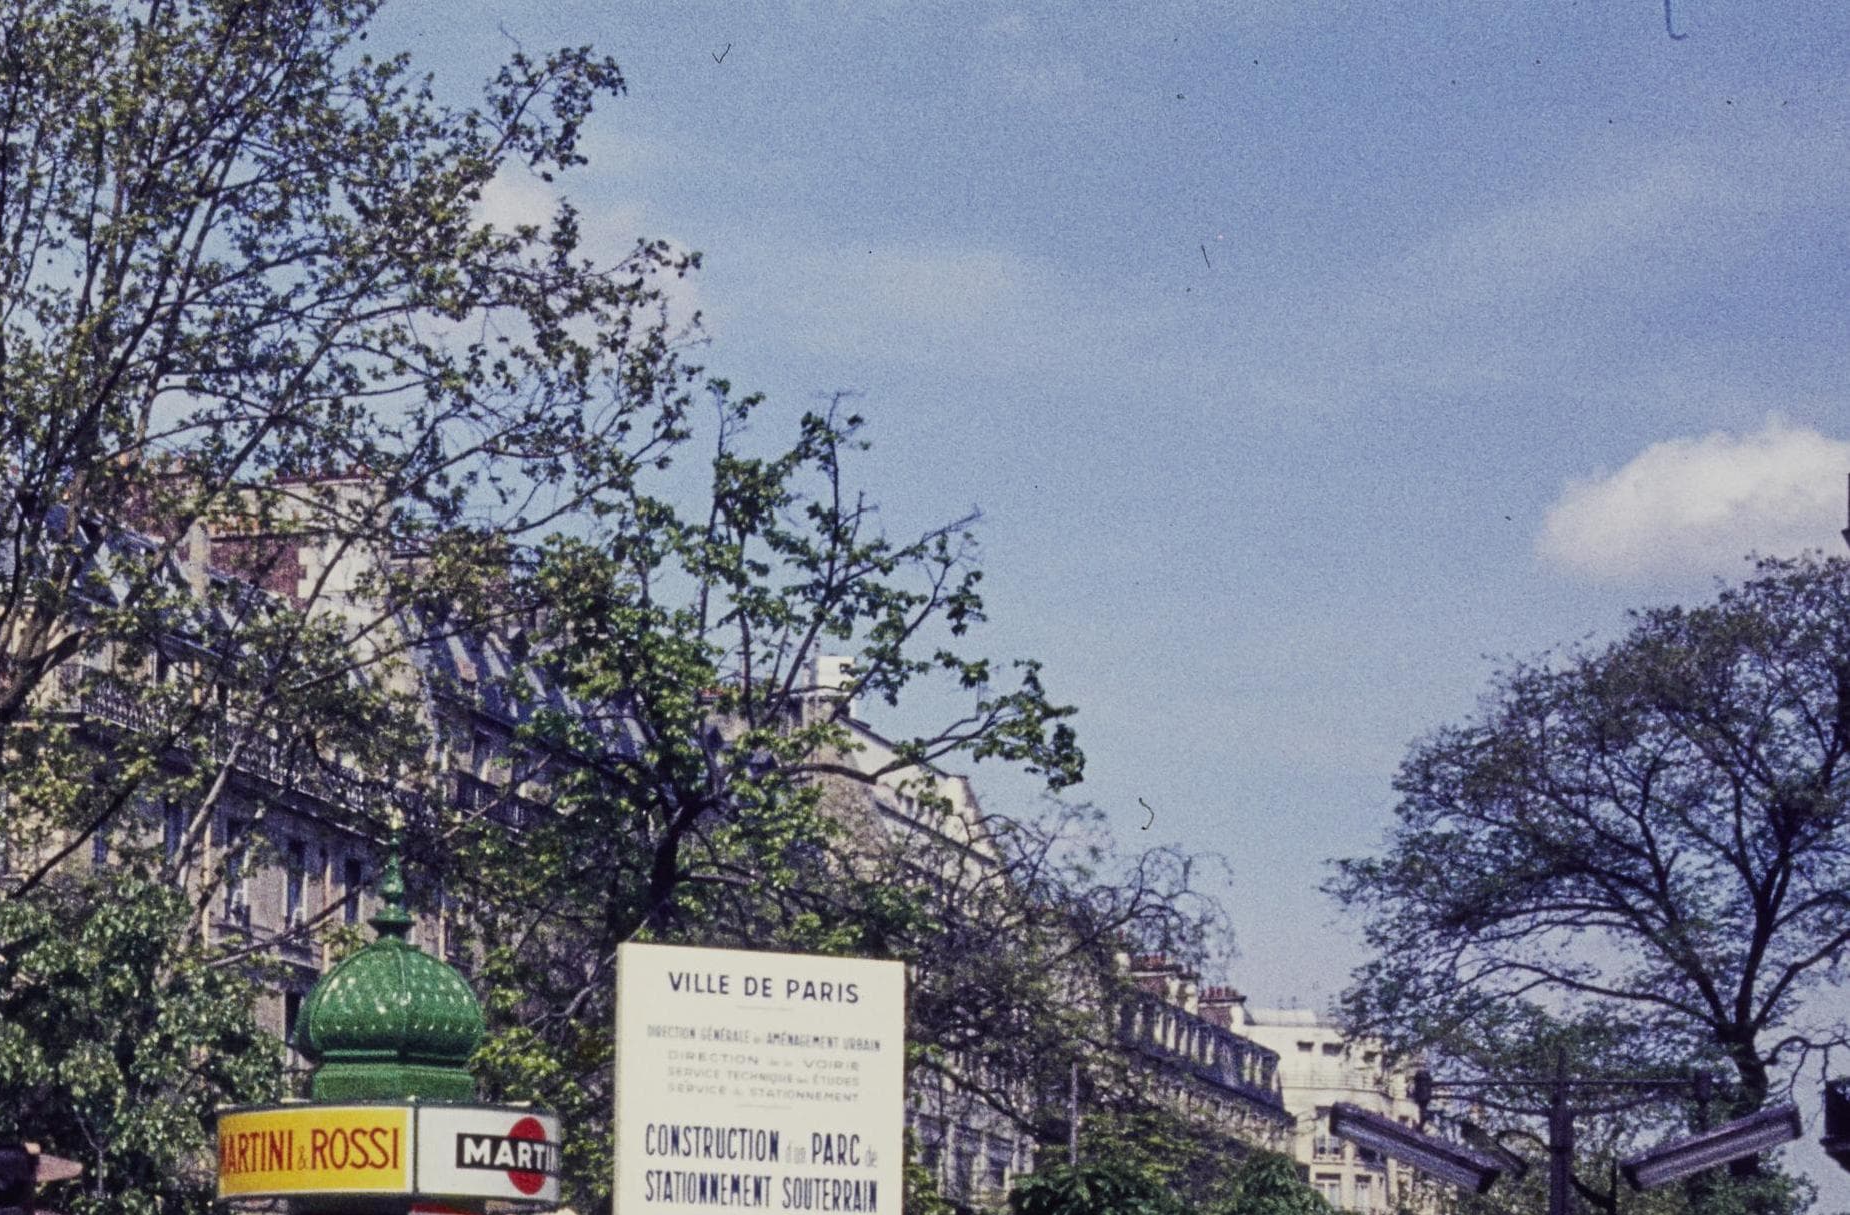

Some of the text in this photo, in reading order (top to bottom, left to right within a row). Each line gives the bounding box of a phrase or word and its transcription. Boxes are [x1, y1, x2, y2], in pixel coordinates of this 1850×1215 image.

[668, 971, 860, 1004] VILLE DE PARIS
[667, 1050, 760, 1066] DIRECTION
[311, 1127, 399, 1170] ROSSI
[463, 1137, 558, 1172] MARTIN
[646, 1123, 780, 1163] CONSTRUCTION
[812, 1132, 861, 1166] PARC
[645, 1170, 878, 1213] STATIONNEMENT SOUTERRAIN
